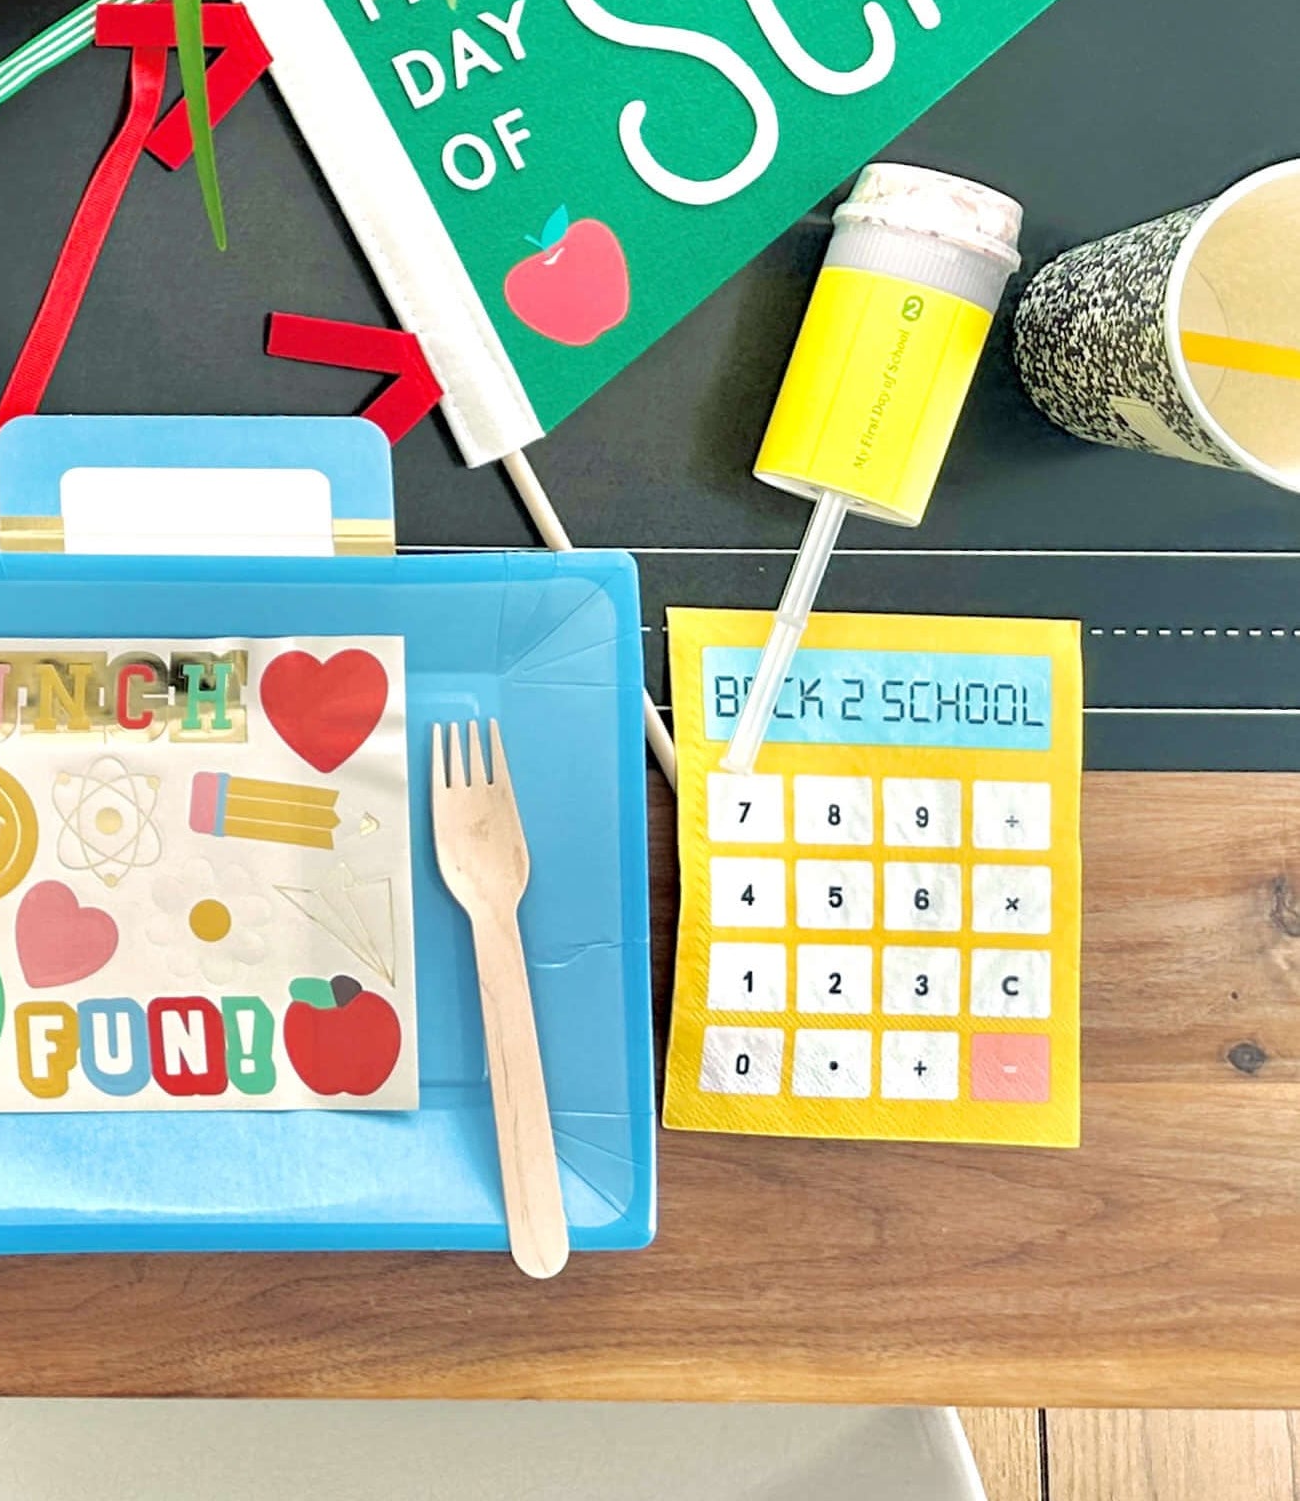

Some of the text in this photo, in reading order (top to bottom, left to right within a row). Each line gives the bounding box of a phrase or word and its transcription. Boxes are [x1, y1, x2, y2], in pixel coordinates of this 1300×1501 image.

[441, 107, 531, 191] OF
[853, 328, 911, 470] My First Day of School
[714, 675, 1045, 727] BCK 2 SCHOOL
[738, 802, 751, 823] 7
[827, 804, 841, 826] 8
[915, 806, 929, 828] 9
[740, 884, 755, 906] 4
[828, 886, 843, 909] 5
[914, 888, 930, 911] 6
[743, 970, 1019, 996] 1 2 3 C
[21, 1003, 266, 1089] FUN!
[735, 1053, 750, 1076] 0
